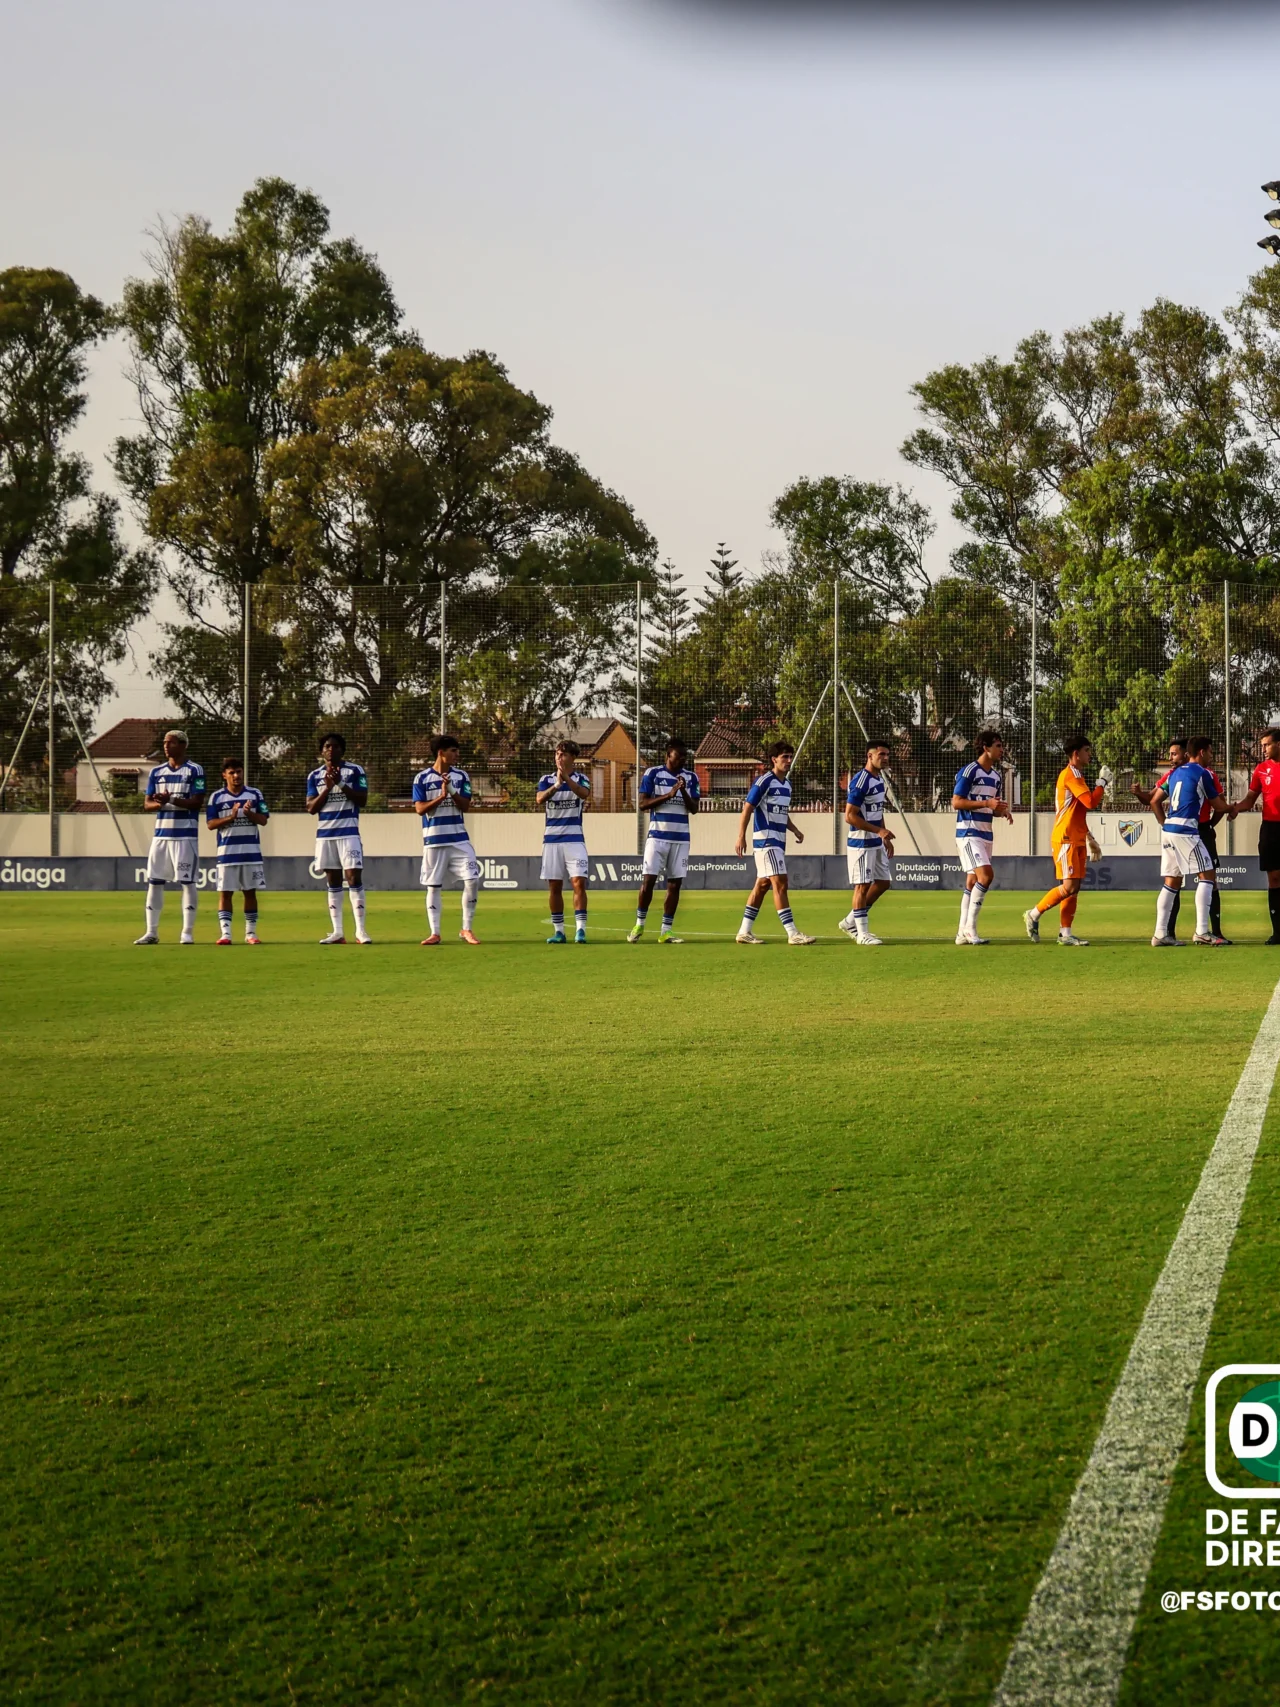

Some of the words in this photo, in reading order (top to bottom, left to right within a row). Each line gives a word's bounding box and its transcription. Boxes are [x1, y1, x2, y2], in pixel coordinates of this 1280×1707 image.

[1171, 781, 1182, 811] 4
[706, 862, 747, 871] Provincial
[895, 863, 940, 873] Diputación
[621, 874, 629, 882] de
[895, 874, 907, 882] de
[908, 873, 940, 883] Málaga
